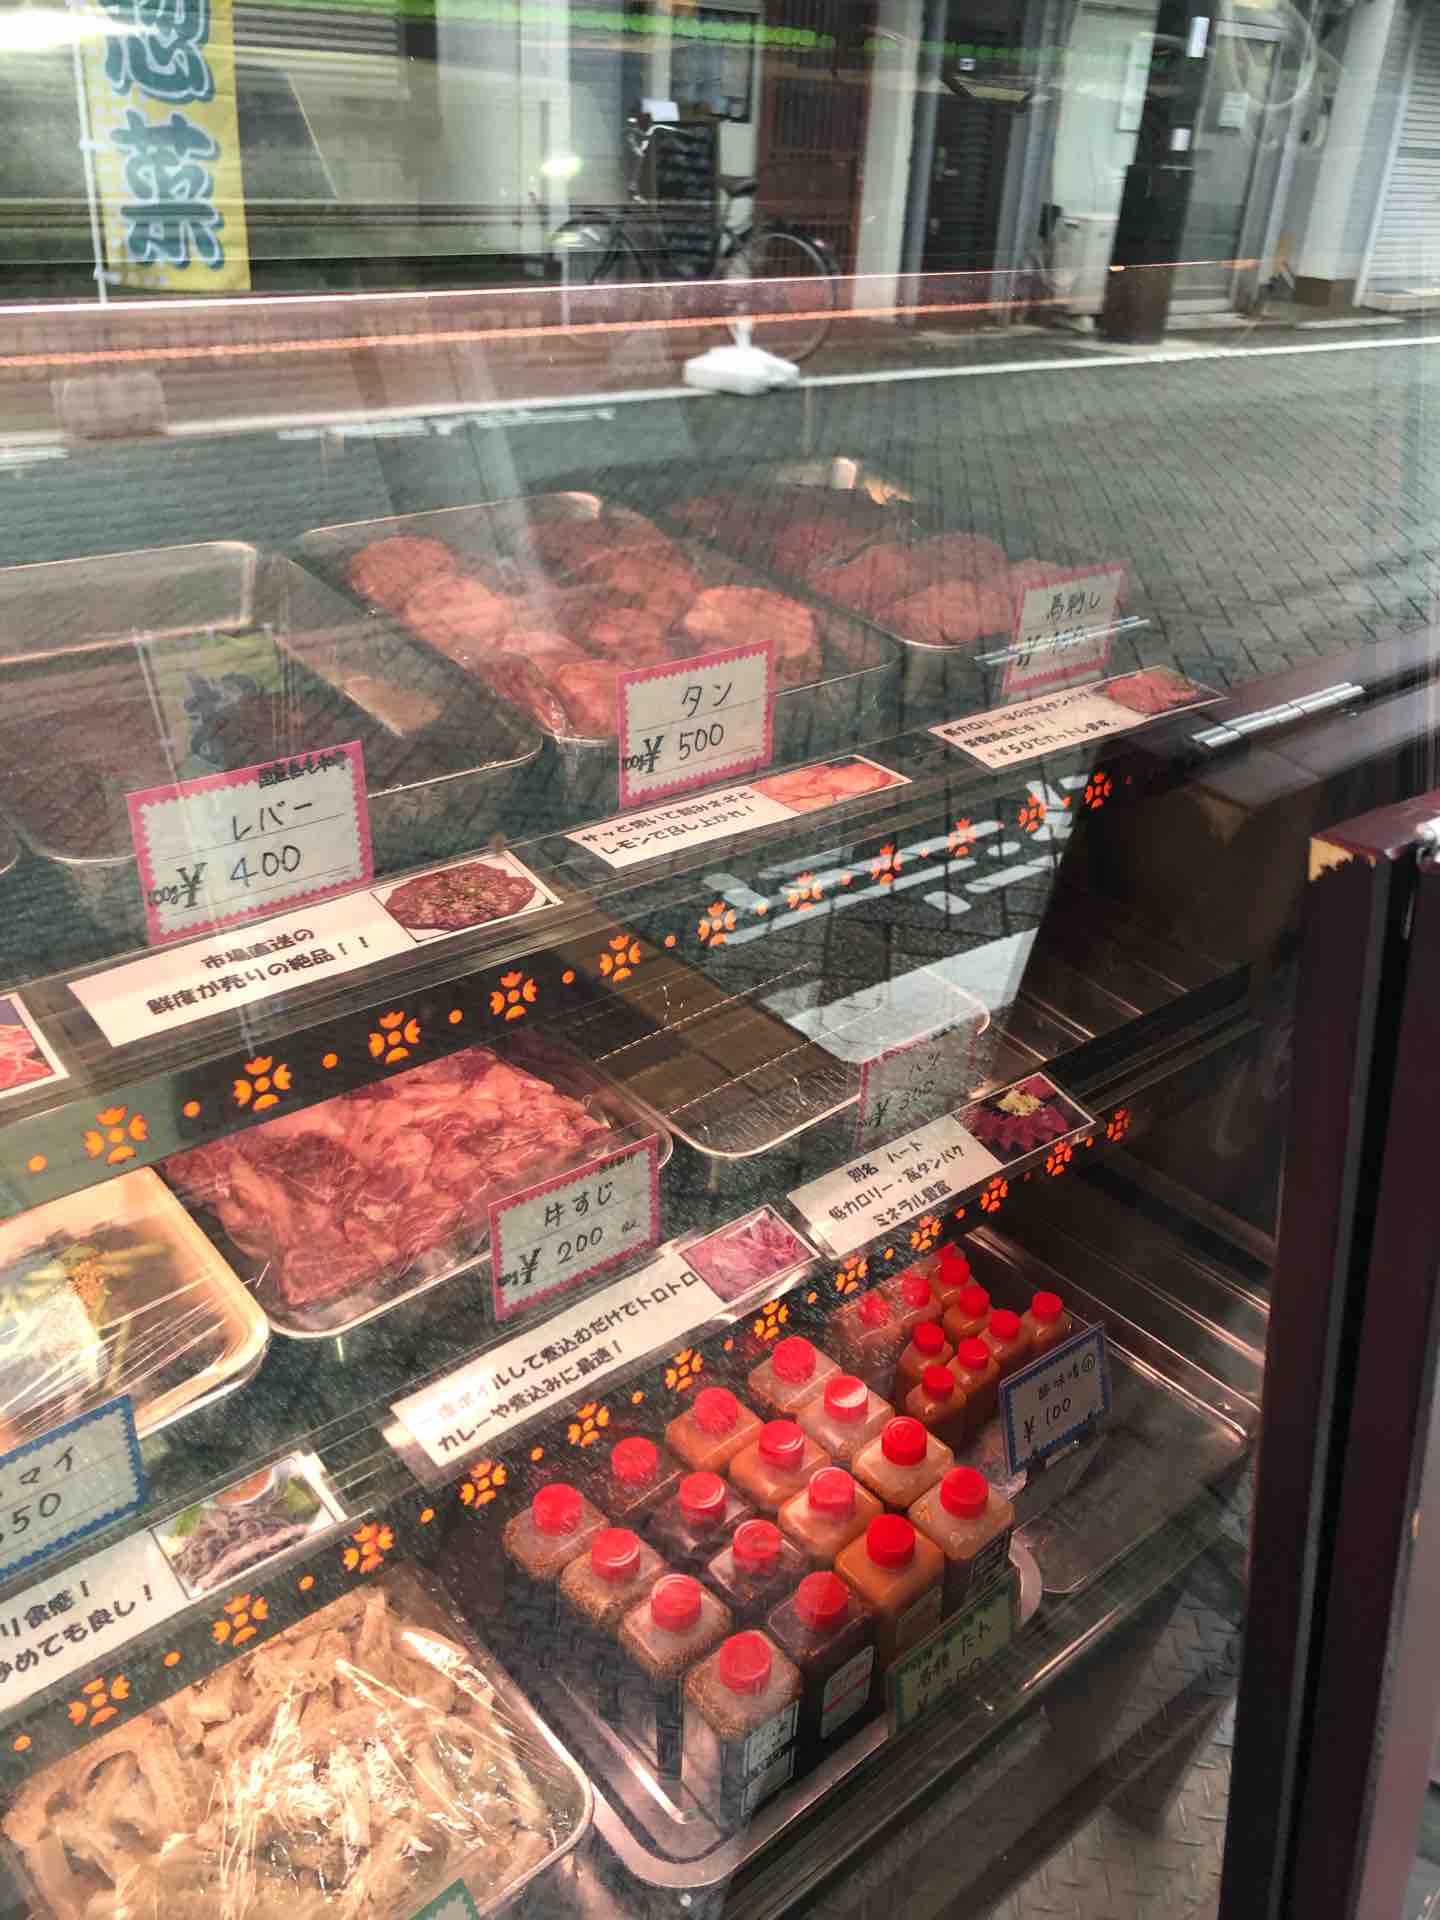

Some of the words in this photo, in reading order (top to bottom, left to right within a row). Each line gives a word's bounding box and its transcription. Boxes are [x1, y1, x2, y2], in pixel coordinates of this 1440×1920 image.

[681, 681, 733, 718] タン
[679, 723, 724, 761] 500
[231, 800, 313, 841] レバー
[230, 845, 301, 888] 400
[201, 928, 315, 970] 市場直送の
[886, 1140, 924, 1165] ハート
[544, 1181, 614, 1228] 牛すじ
[557, 1226, 604, 1265] 200
[1045, 1397, 1072, 1426] 100
[0, 1445, 74, 1497] マイ
[0, 1492, 62, 1545] 50
